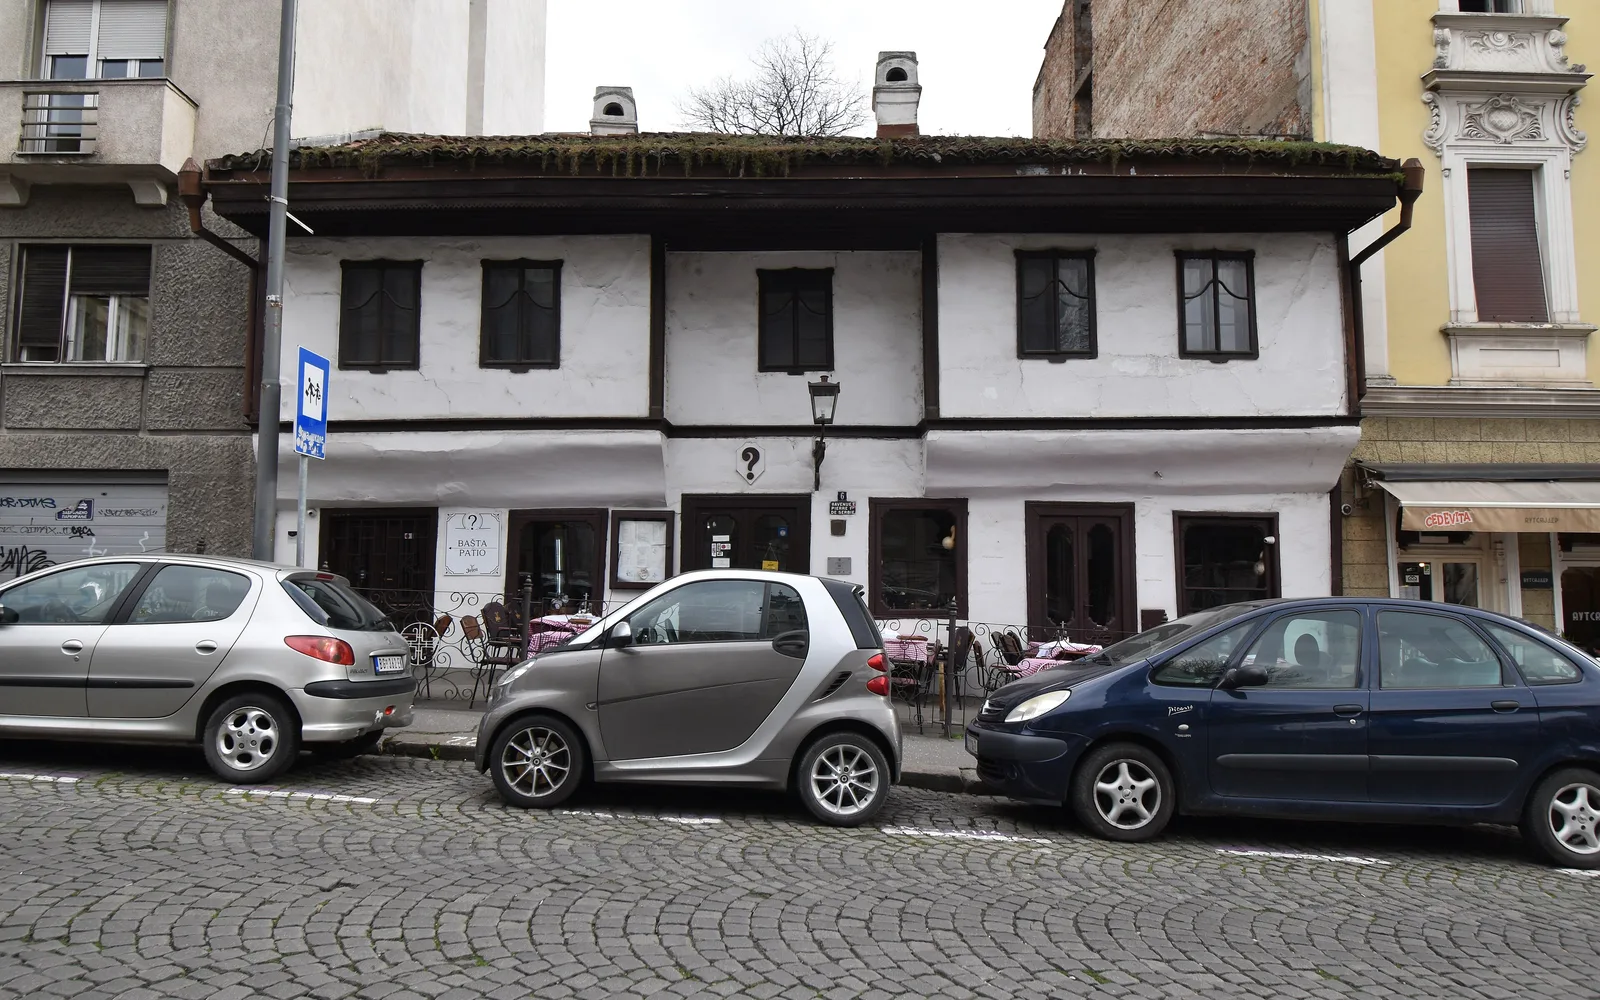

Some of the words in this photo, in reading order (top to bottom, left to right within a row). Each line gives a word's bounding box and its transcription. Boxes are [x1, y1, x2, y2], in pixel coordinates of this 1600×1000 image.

[741, 446, 760, 480] ?
[467, 514, 477, 530] ?
[1425, 511, 1472, 527] CEDEVITA
[458, 538, 487, 547] BAŠTA
[459, 549, 486, 557] PATIO
